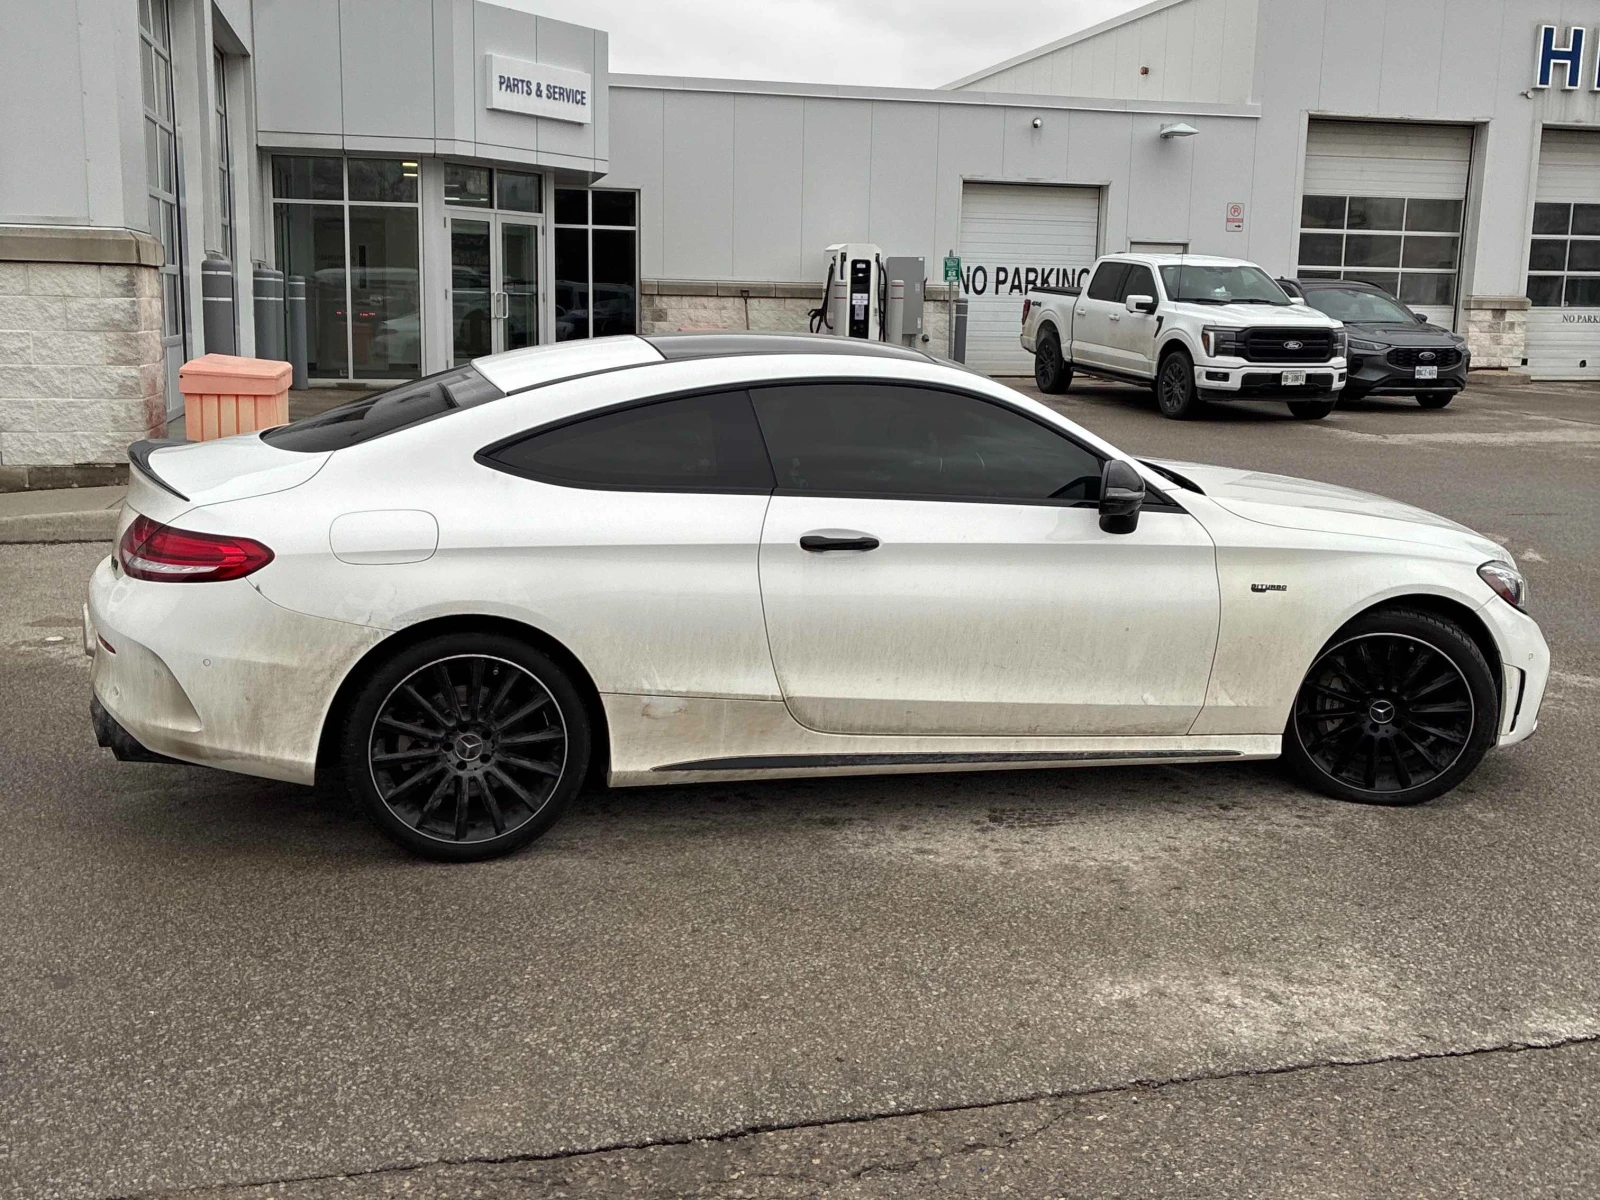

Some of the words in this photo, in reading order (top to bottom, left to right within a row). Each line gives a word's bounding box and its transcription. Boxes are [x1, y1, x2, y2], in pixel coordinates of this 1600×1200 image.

[1536, 24, 1600, 91] H
[498, 75, 532, 96] PARTS
[535, 82, 543, 98] &
[546, 84, 586, 106] SERVICE
[959, 265, 988, 296] NO
[1562, 314, 1576, 323] NO
[1577, 314, 1600, 324] PARK
